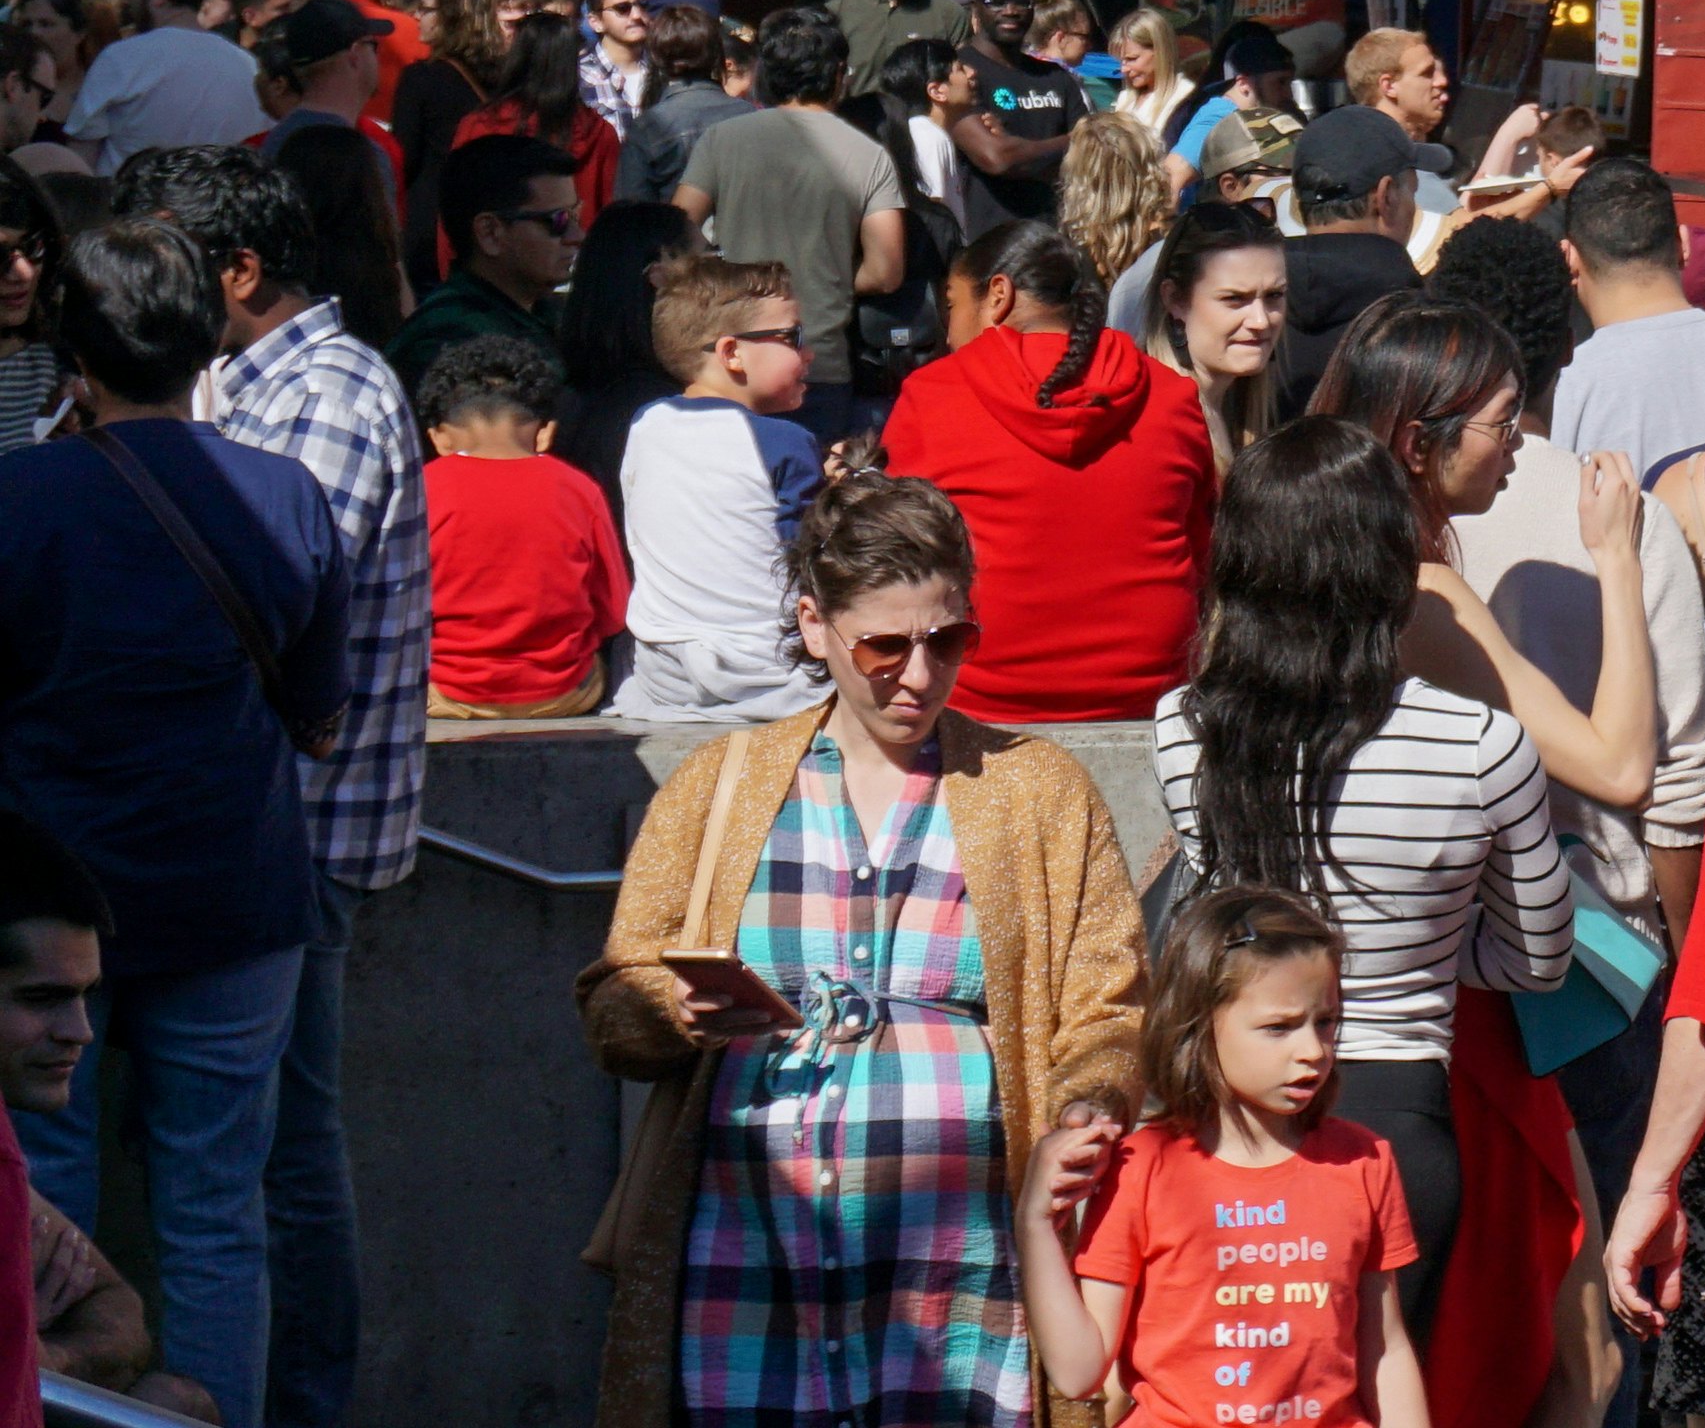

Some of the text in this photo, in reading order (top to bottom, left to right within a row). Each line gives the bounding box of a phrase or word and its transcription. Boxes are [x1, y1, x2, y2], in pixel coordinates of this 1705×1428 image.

[1215, 1200, 1286, 1228] kind
[1217, 1236, 1328, 1270] people
[1216, 1281, 1329, 1309] are my
[1215, 1322, 1290, 1348] kind
[1215, 1362, 1252, 1386] of
